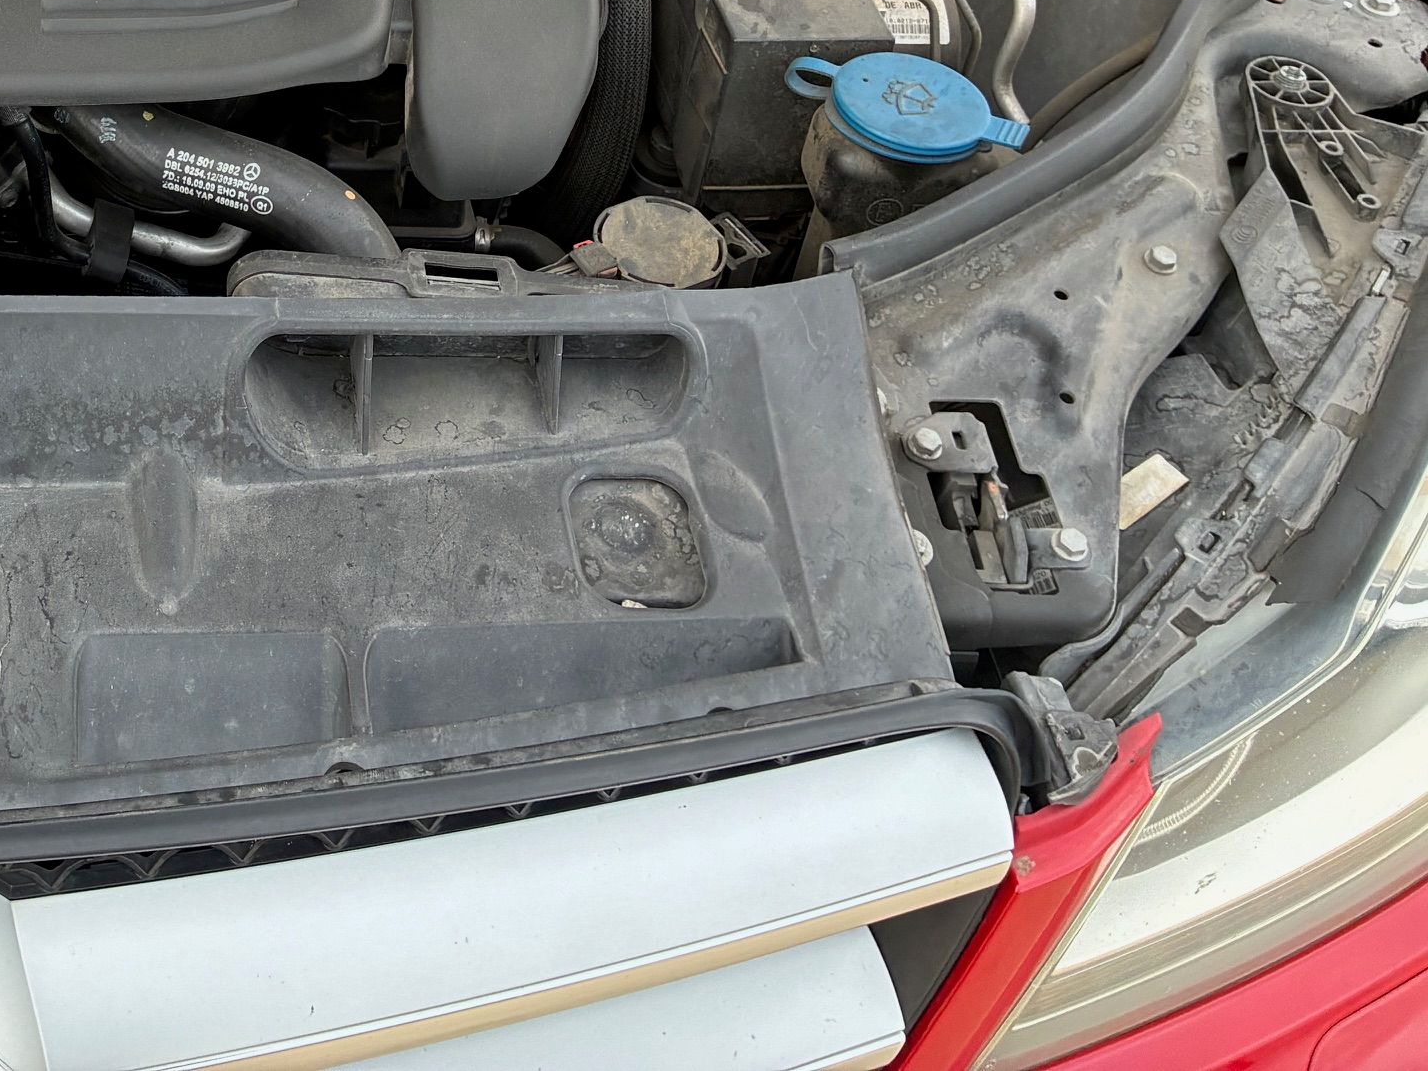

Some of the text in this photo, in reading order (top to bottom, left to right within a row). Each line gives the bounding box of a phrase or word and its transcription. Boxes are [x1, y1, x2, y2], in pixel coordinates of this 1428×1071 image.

[166, 147, 175, 159] A
[176, 150, 196, 164] 204
[196, 156, 215, 169] 501
[164, 159, 183, 172] DBL
[195, 190, 214, 201] YAP
[217, 184, 236, 198] EHO
[237, 190, 249, 202] PL
[256, 201, 268, 211] Q1
